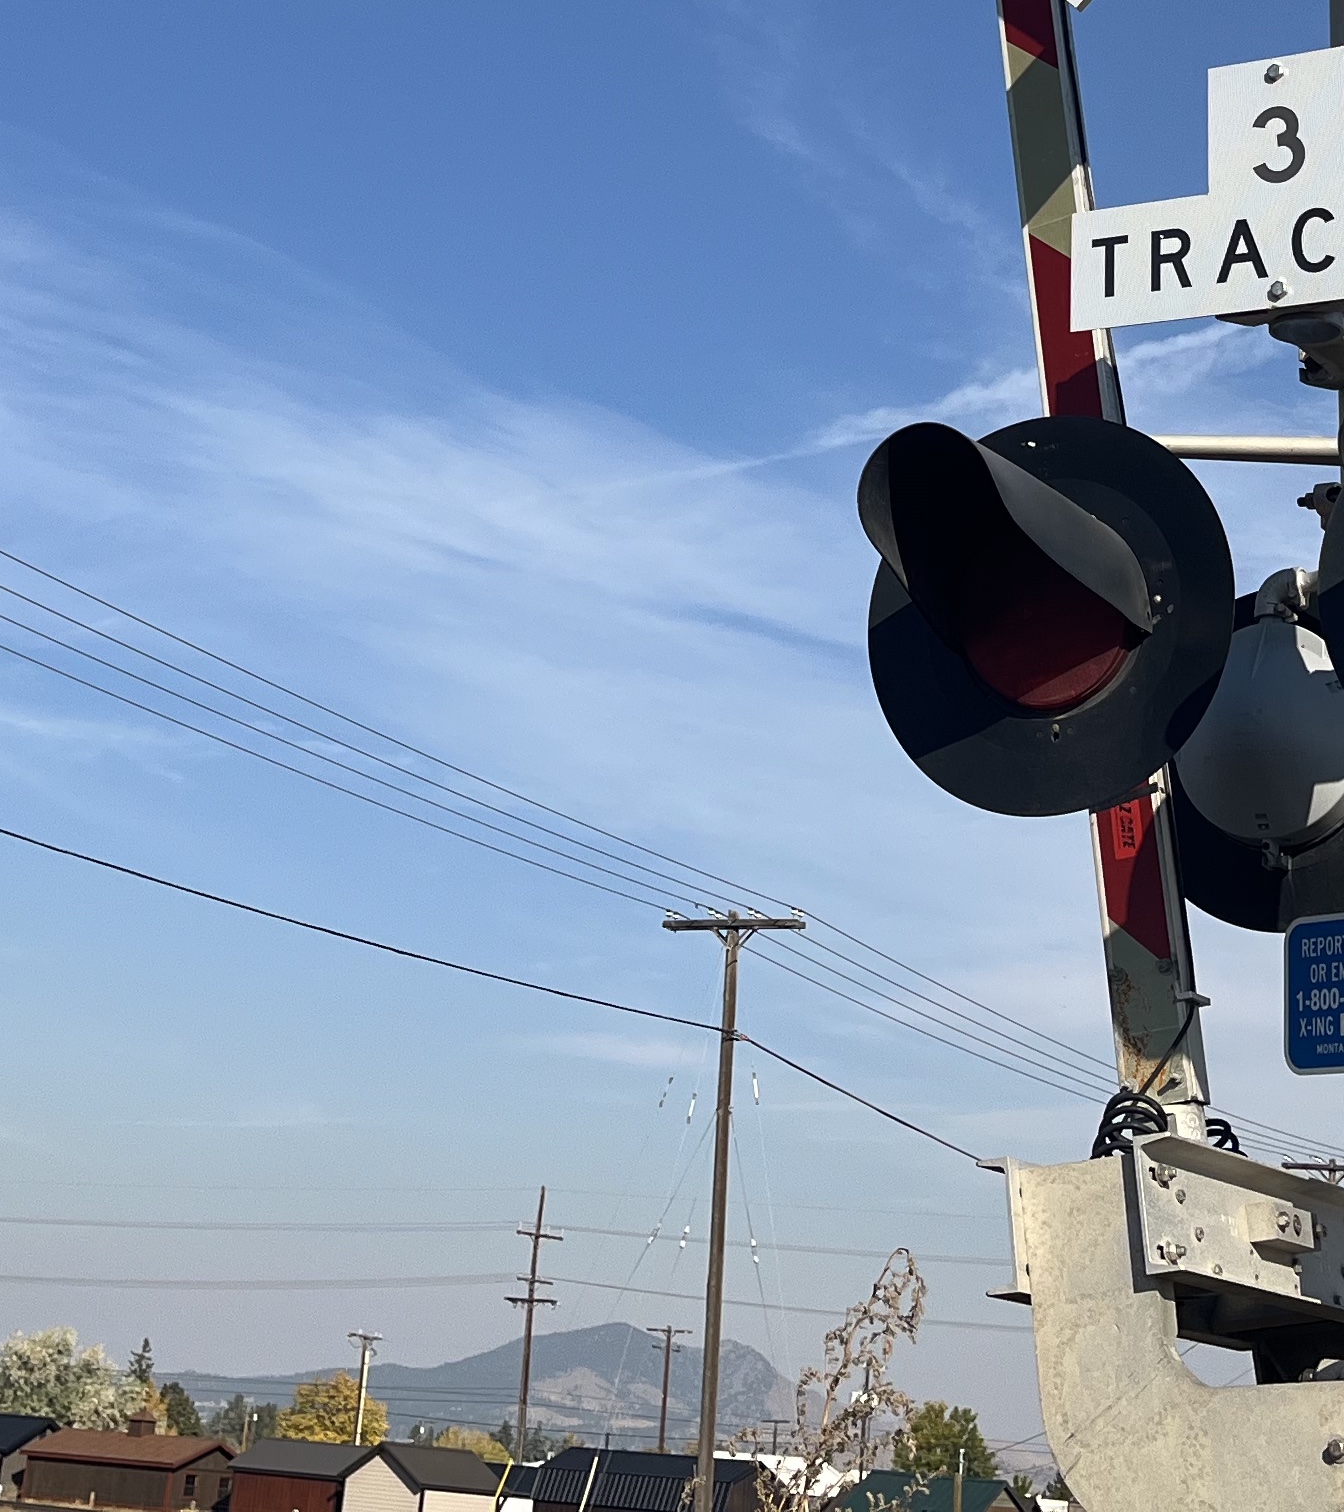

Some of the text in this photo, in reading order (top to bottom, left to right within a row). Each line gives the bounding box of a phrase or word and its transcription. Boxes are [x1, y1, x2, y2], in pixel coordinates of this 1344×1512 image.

[1252, 106, 1306, 183] 3
[1310, 963, 1327, 983] OR
[1299, 1016, 1334, 1037] X-ING
